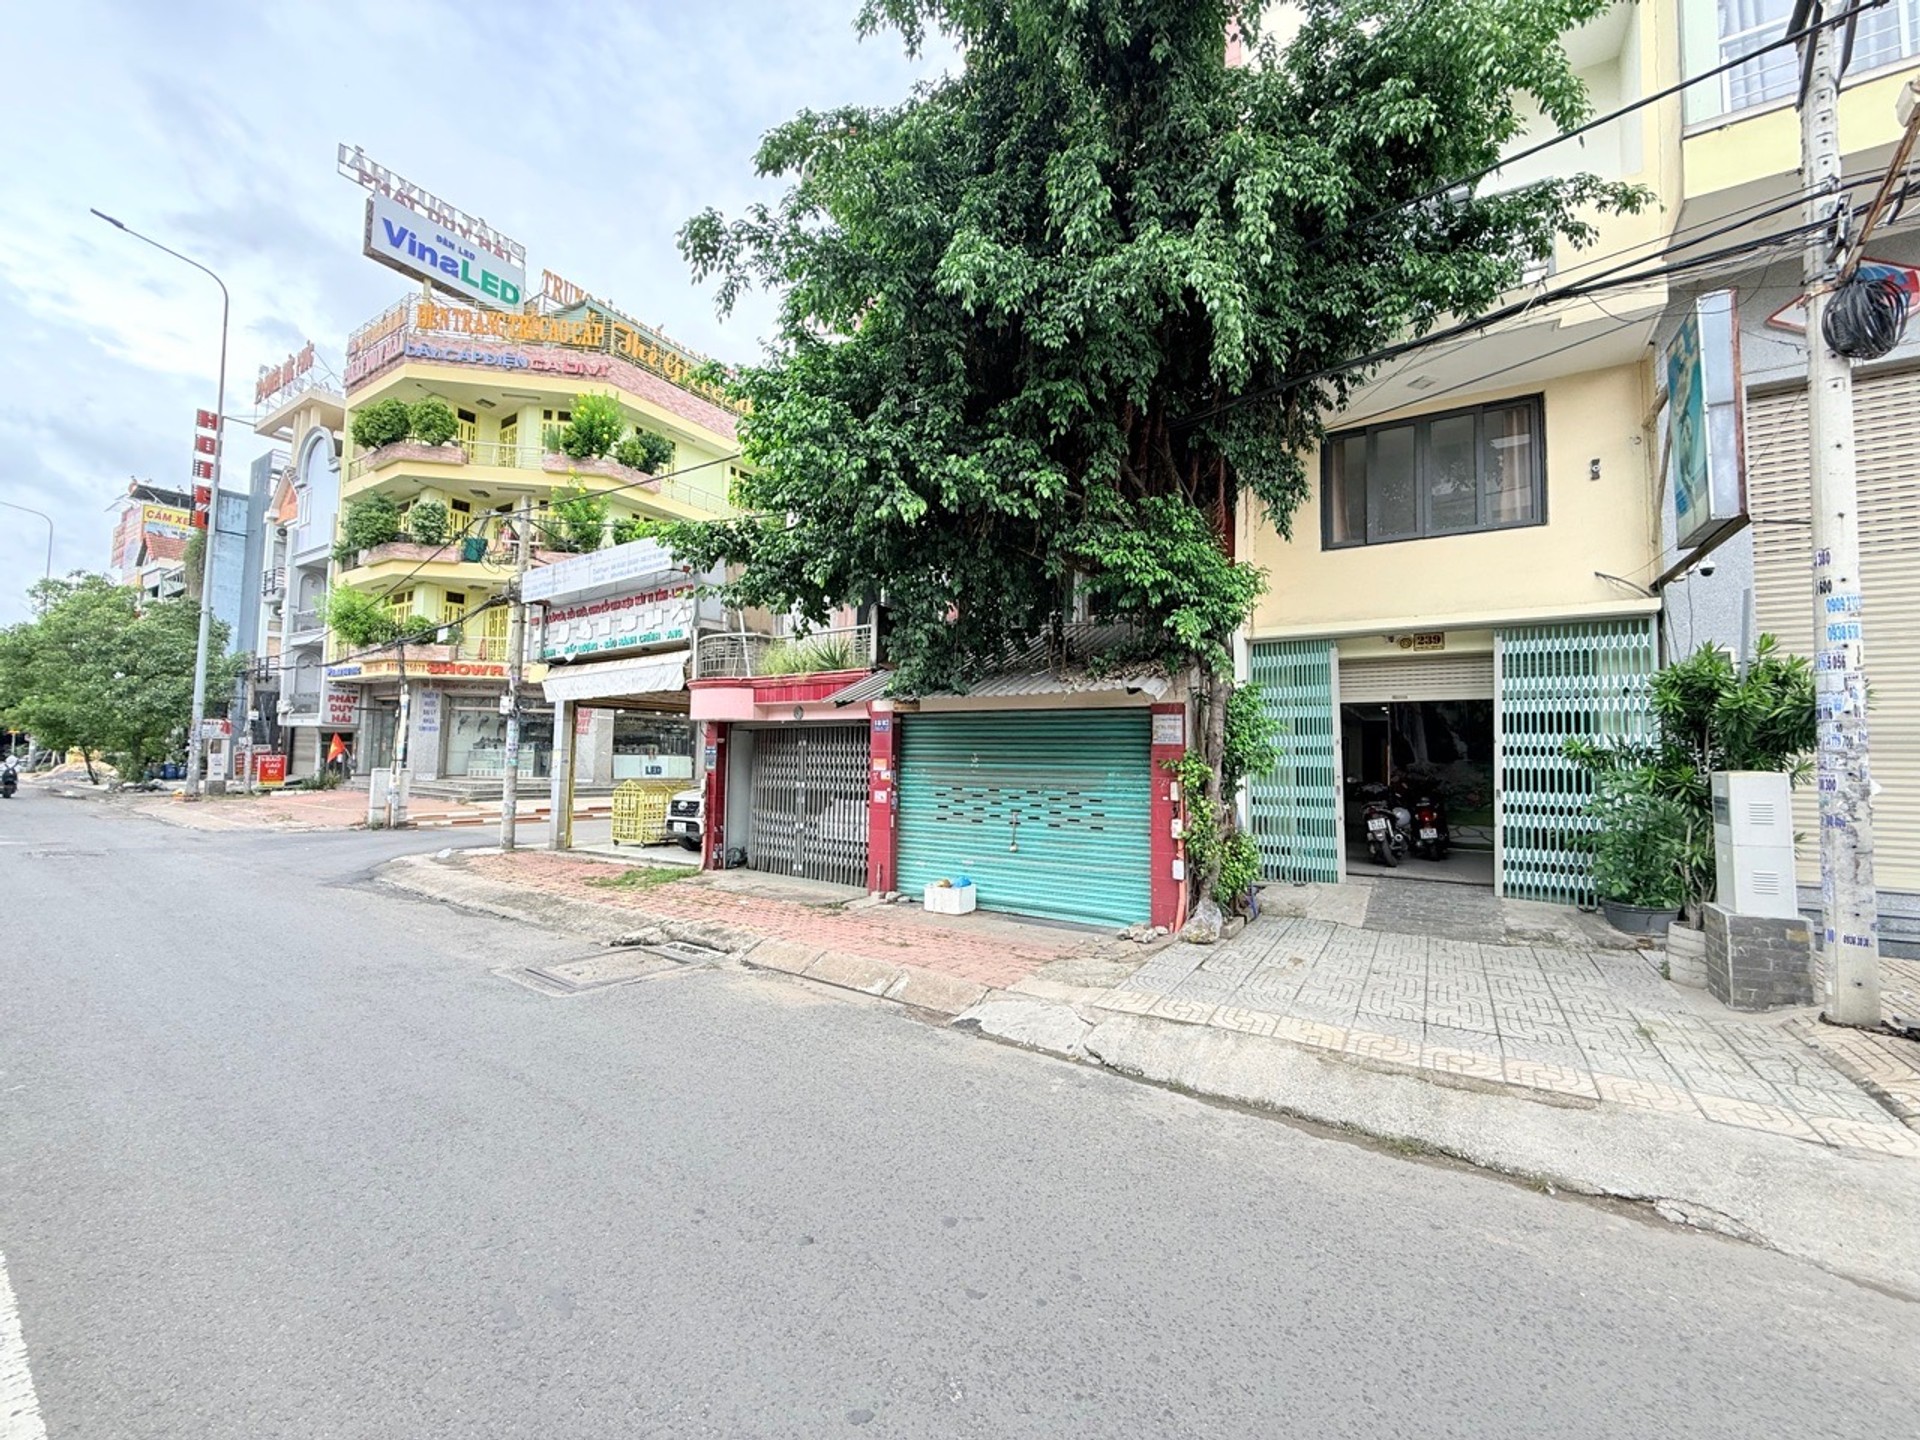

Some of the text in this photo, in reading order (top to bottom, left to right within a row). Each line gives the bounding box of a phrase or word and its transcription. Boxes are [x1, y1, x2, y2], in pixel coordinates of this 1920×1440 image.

[458, 246, 476, 261] LED
[382, 217, 520, 306] VinaLED
[539, 317, 568, 344] CAO
[1416, 634, 1442, 646] 239
[330, 704, 354, 713] DUY
[645, 765, 662, 775] LED
